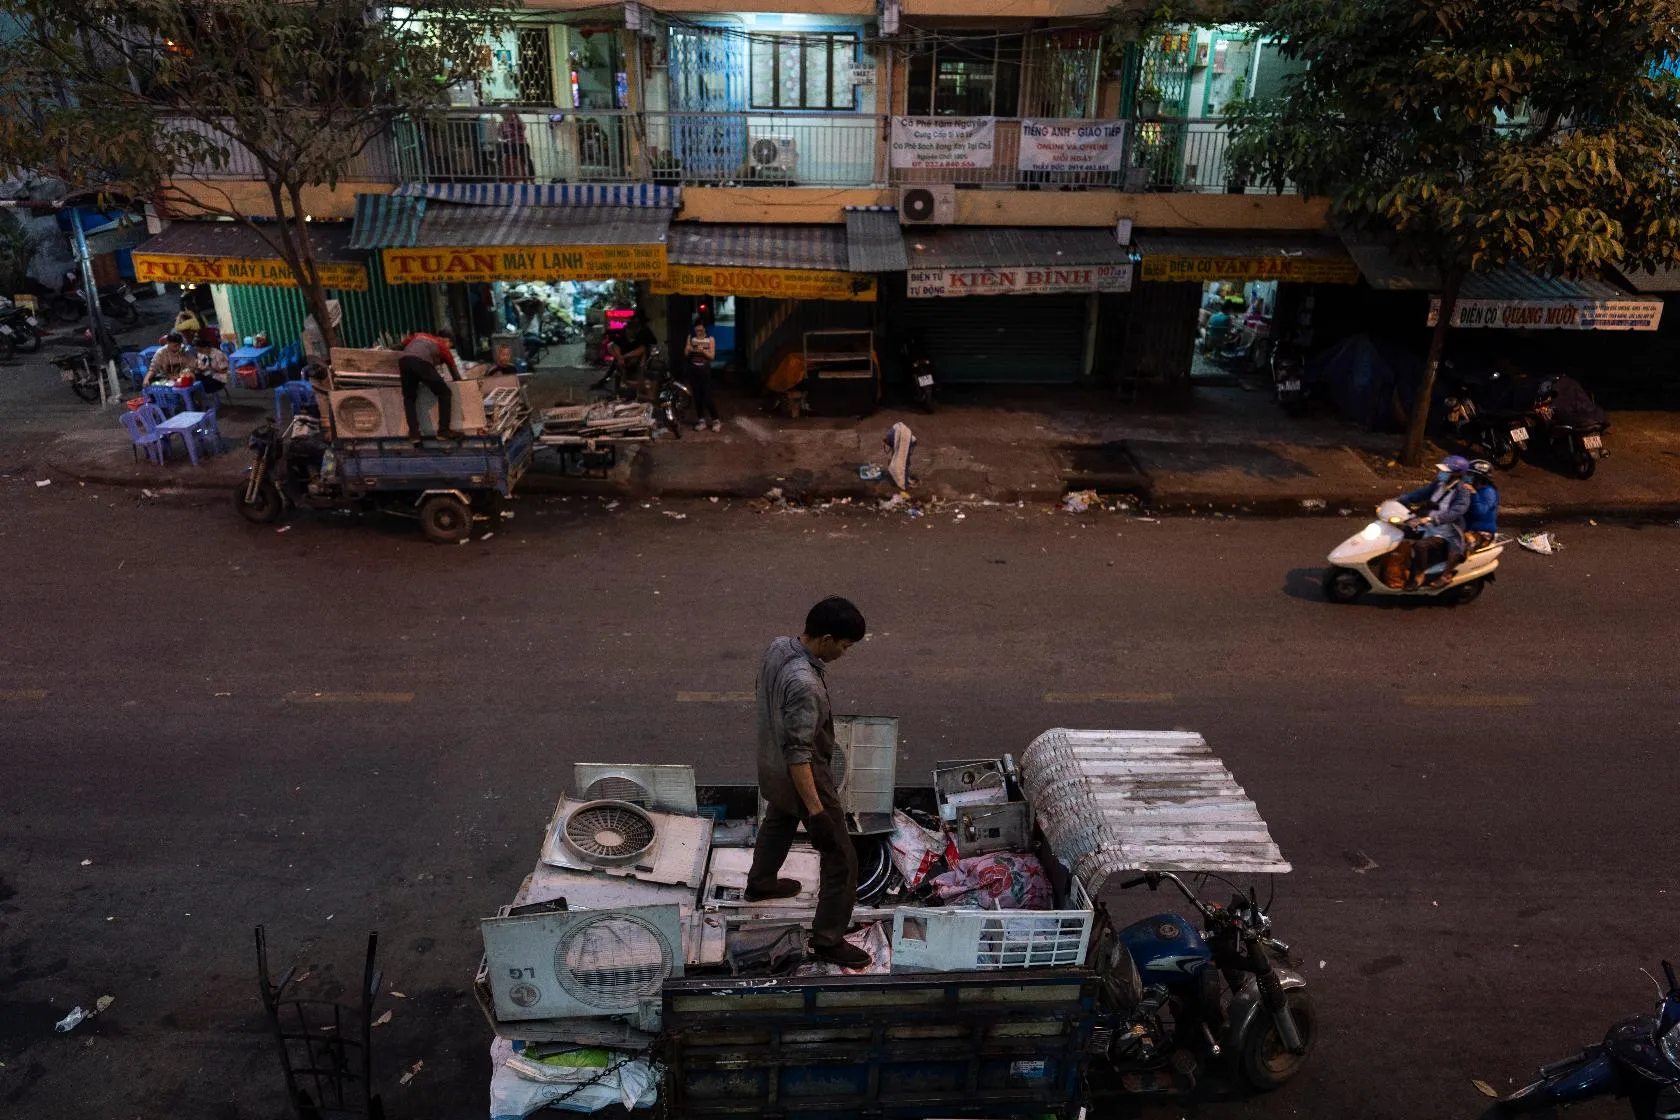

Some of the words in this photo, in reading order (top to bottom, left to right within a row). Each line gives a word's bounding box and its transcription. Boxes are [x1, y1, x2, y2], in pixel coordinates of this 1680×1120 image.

[916, 119, 932, 127] Phê
[1023, 122, 1049, 136] TIẾNG
[1051, 127, 1070, 137] ANH
[1078, 128, 1102, 137] GIAO
[1104, 125, 1122, 137] TIẾP
[904, 142, 917, 150] Phê
[503, 248, 536, 270] MÁY
[542, 252, 585, 272] LẠNH
[227, 259, 258, 278] MÁY
[1024, 266, 1093, 286] BÌNH
[922, 286, 945, 297] ĐỘNG
[1502, 306, 1545, 327] QUANG
[509, 967, 535, 979] LG
